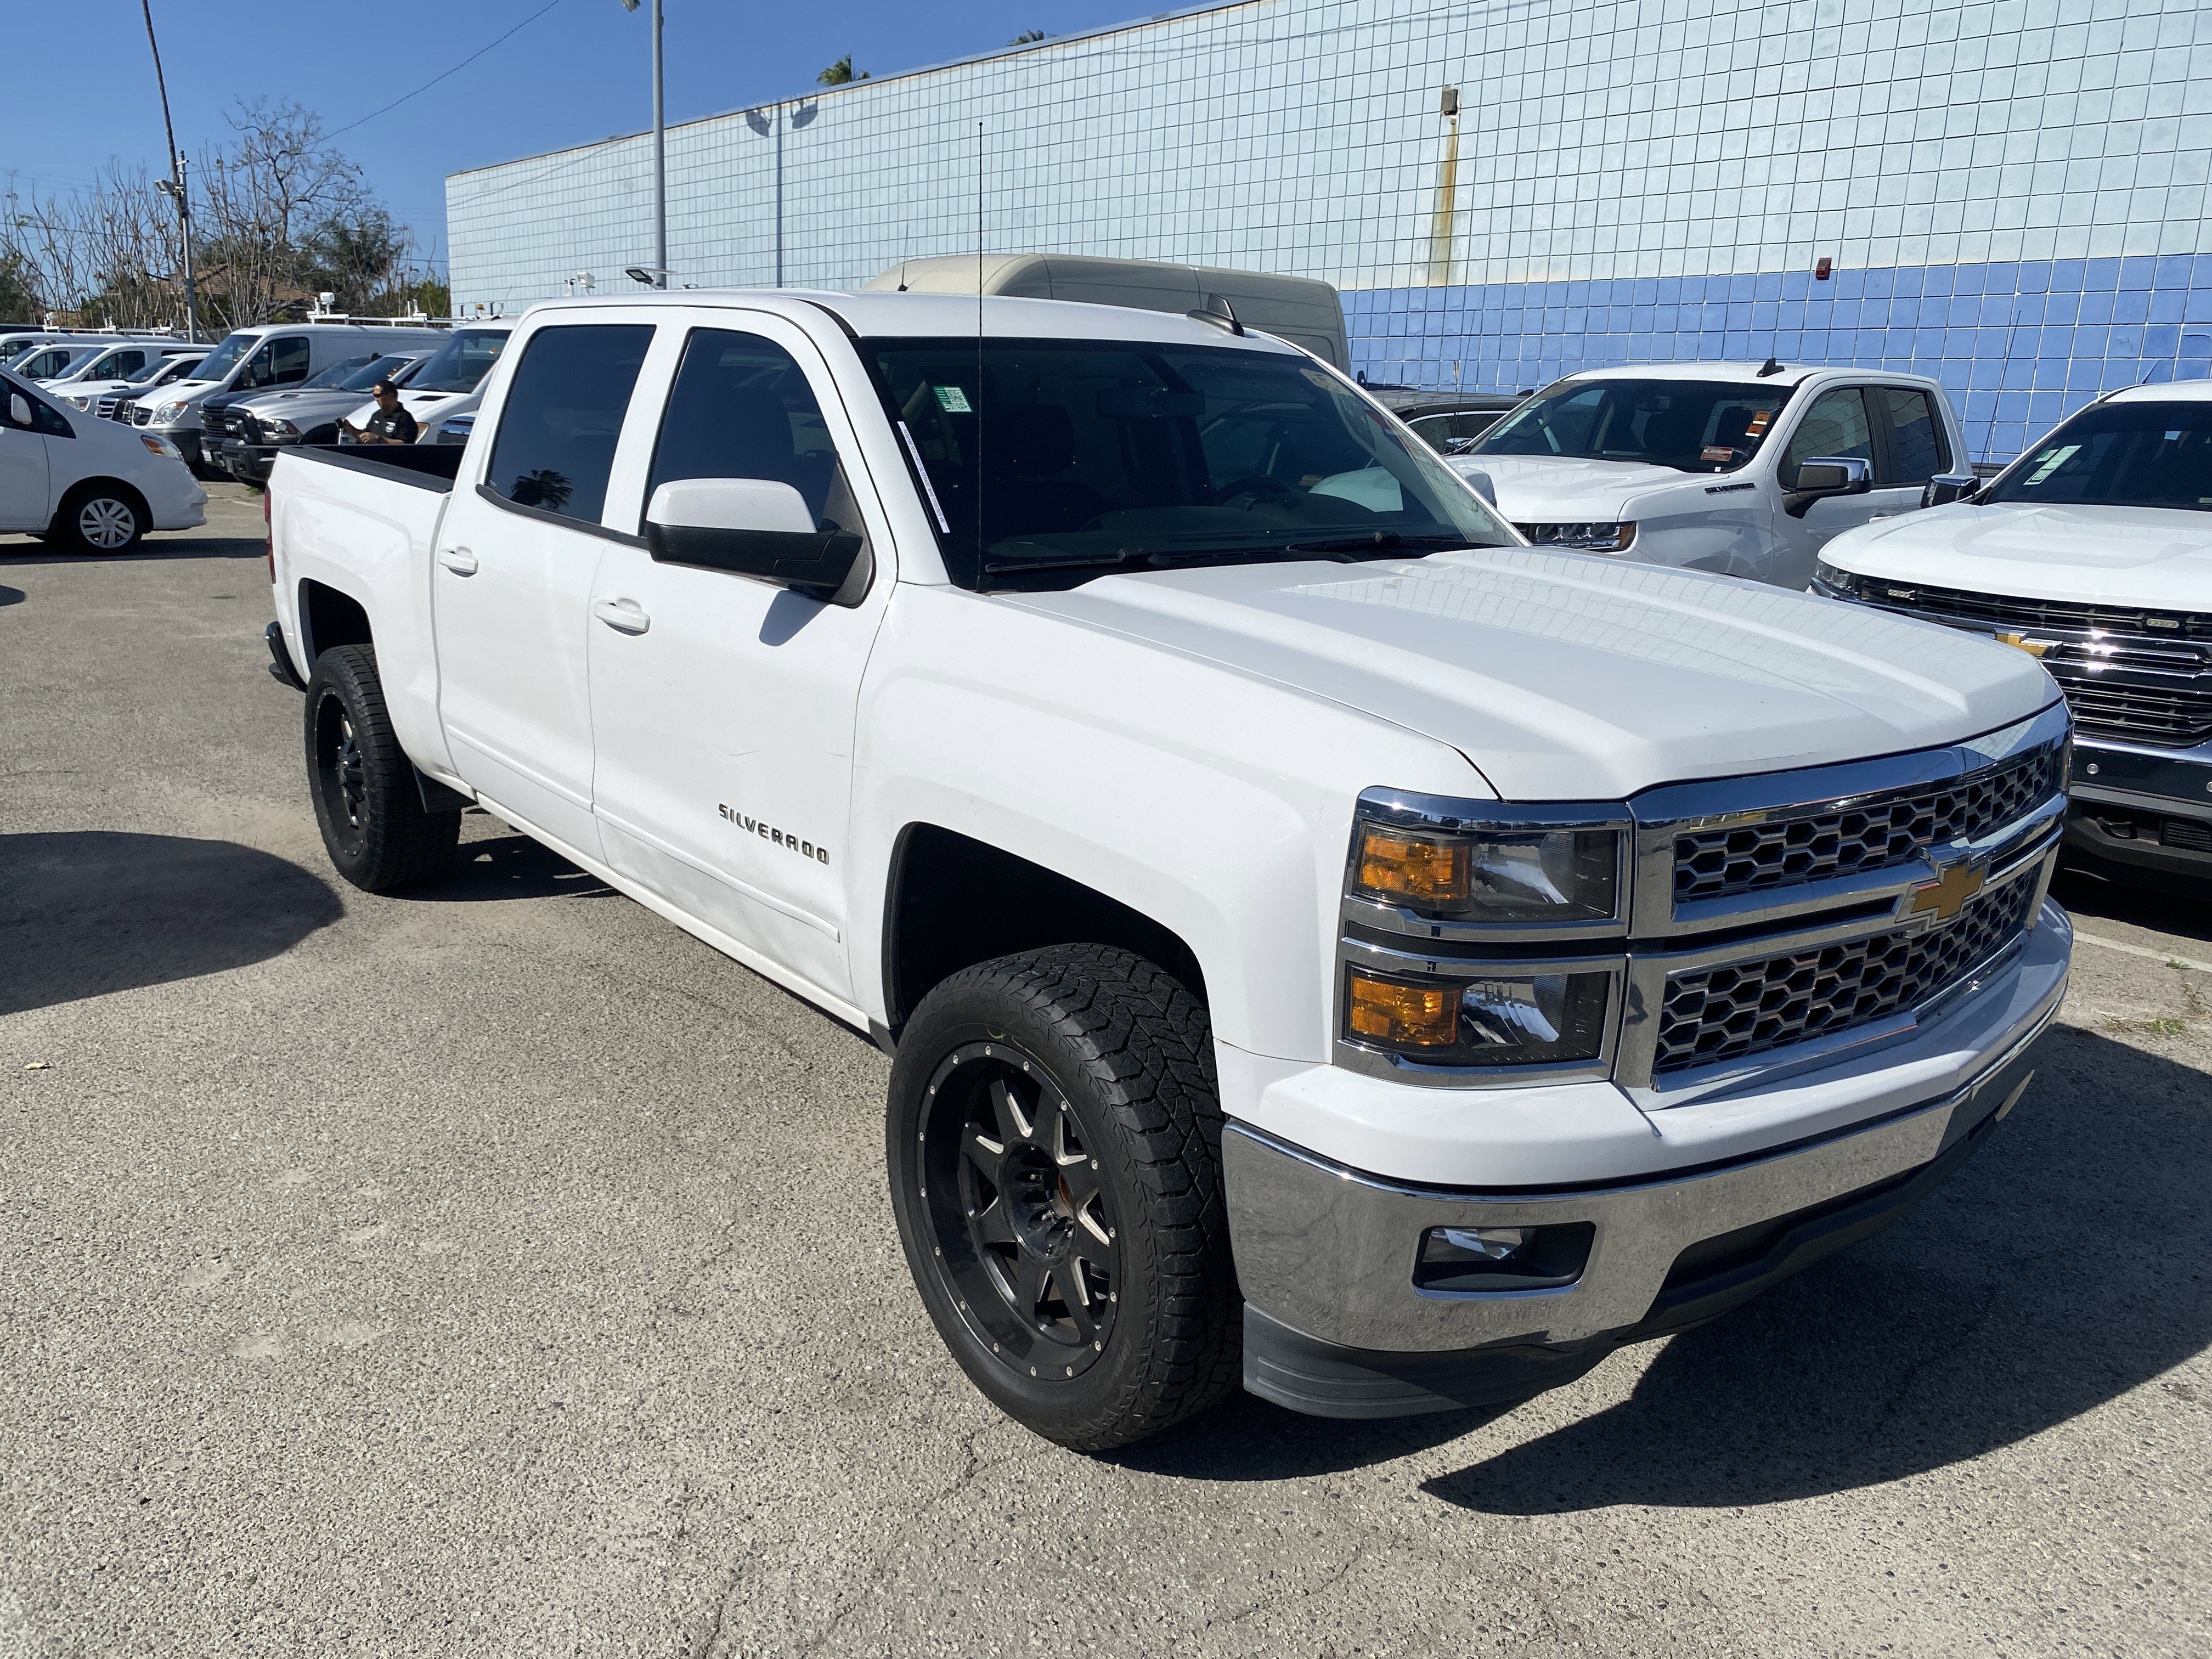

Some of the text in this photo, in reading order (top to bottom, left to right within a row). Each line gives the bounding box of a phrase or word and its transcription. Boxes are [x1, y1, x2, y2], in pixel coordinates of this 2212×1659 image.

[913, 453, 923, 467] CHEVY
[918, 466, 930, 489] SILVERADO
[1704, 482, 1755, 494] SILVERADO
[719, 803, 829, 865] SILVERADO
